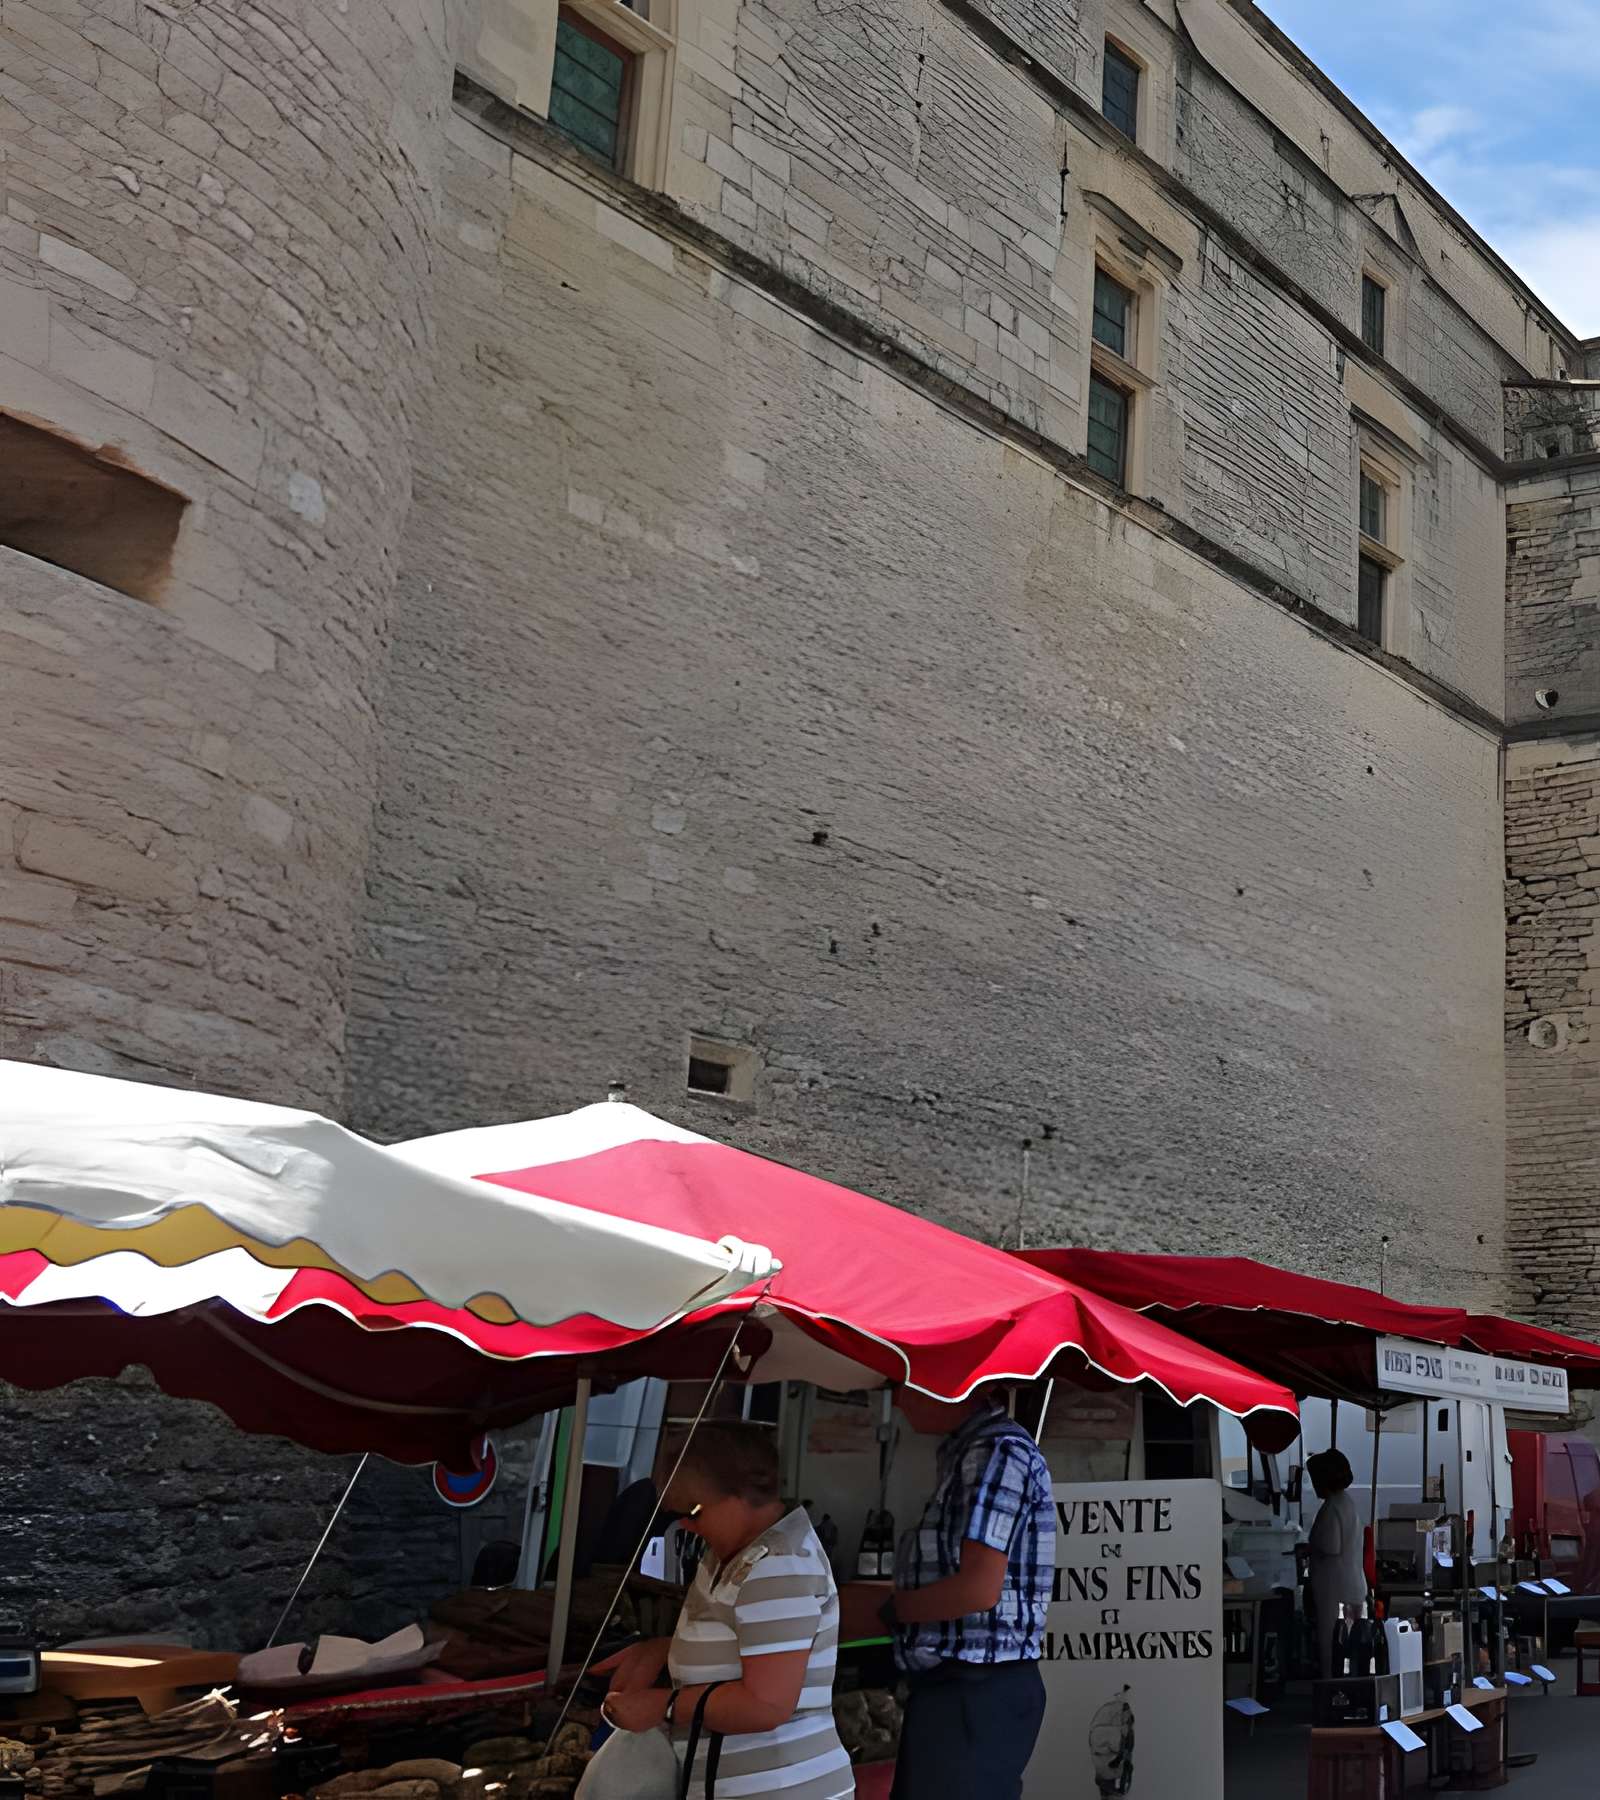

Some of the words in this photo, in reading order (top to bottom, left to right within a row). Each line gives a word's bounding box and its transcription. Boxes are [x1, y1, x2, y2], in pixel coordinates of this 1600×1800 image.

[1056, 1498, 1172, 1535] VENTE
[1051, 1566, 1108, 1601] INS
[1126, 1564, 1202, 1601] FINS
